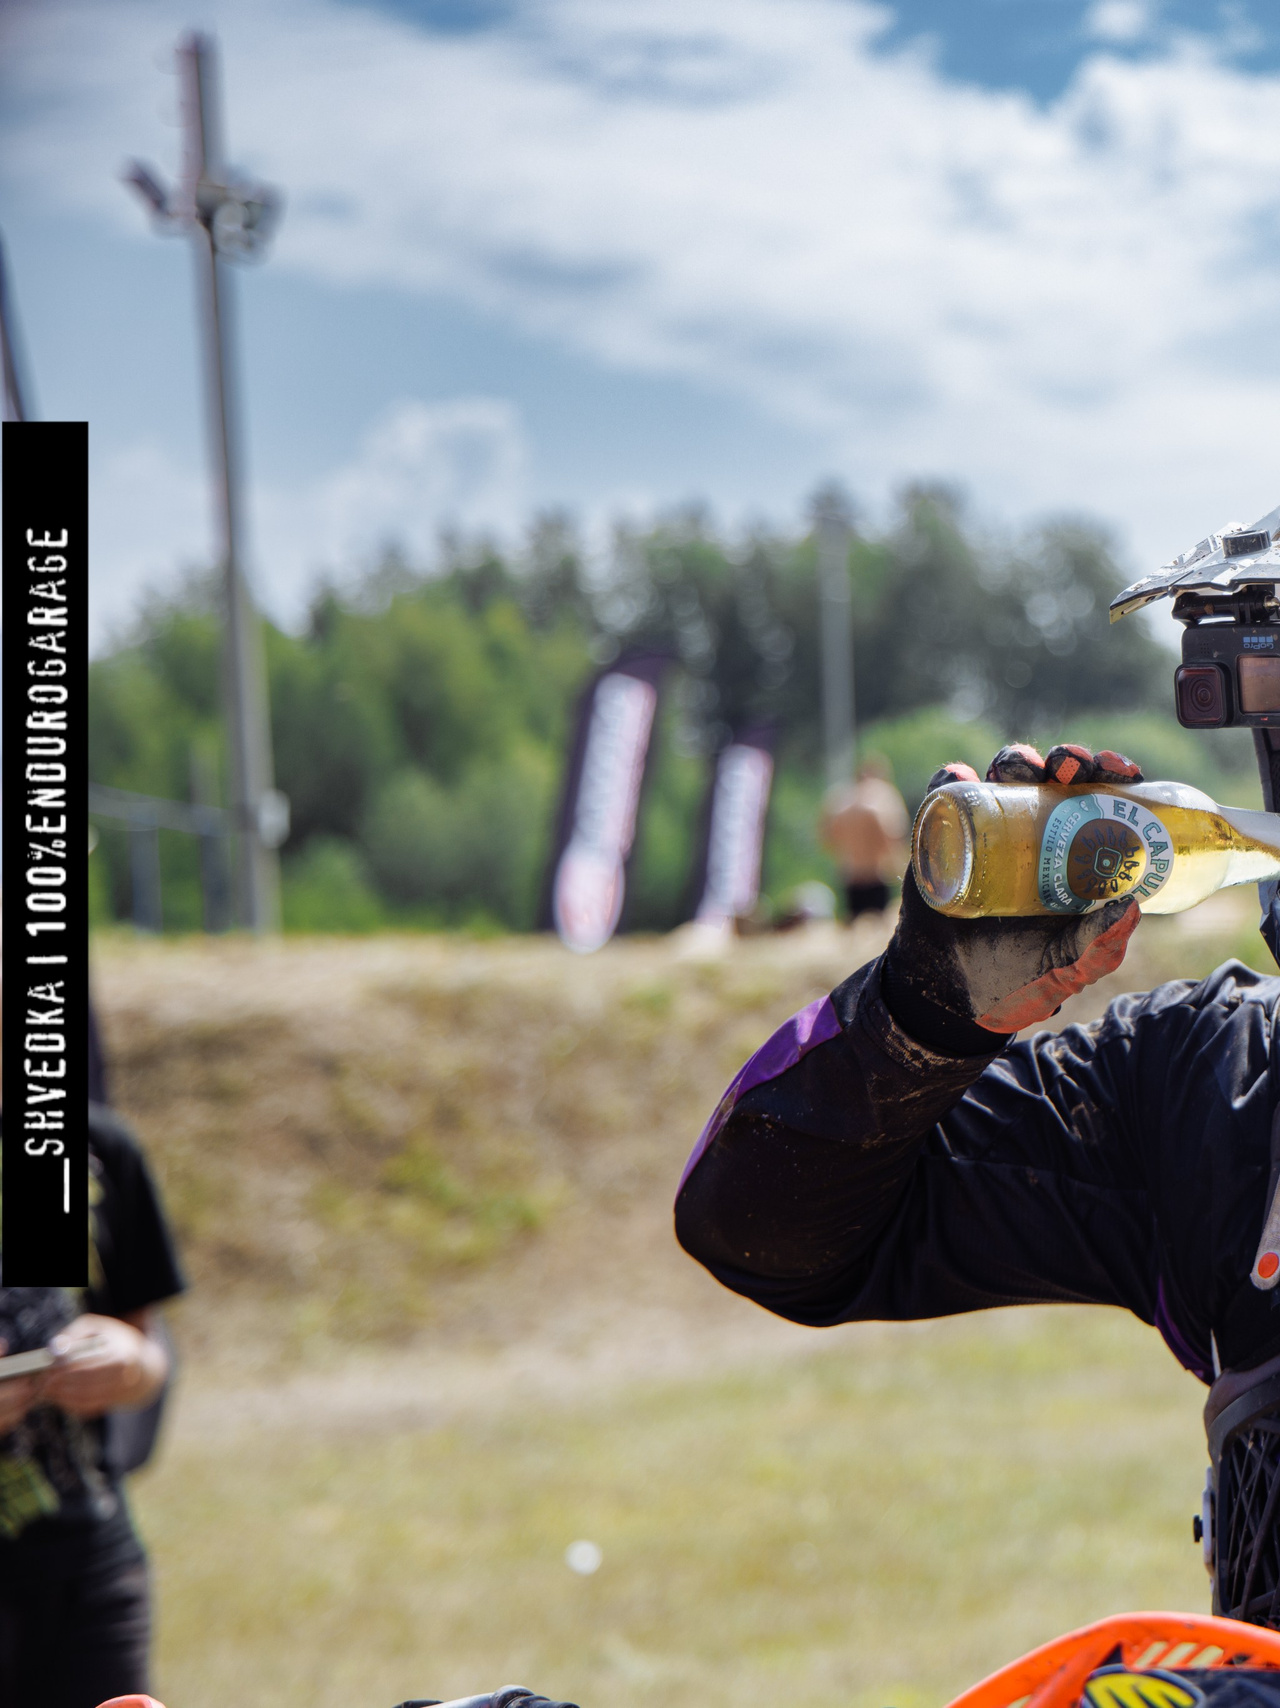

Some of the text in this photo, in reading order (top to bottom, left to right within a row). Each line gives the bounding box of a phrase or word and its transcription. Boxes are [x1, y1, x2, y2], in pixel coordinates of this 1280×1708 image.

[1112, 799, 1139, 827] EL
[1045, 817, 1062, 853] ESTILO
[1053, 812, 1081, 869] CERVEZA
[1053, 873, 1073, 906] CLARA
